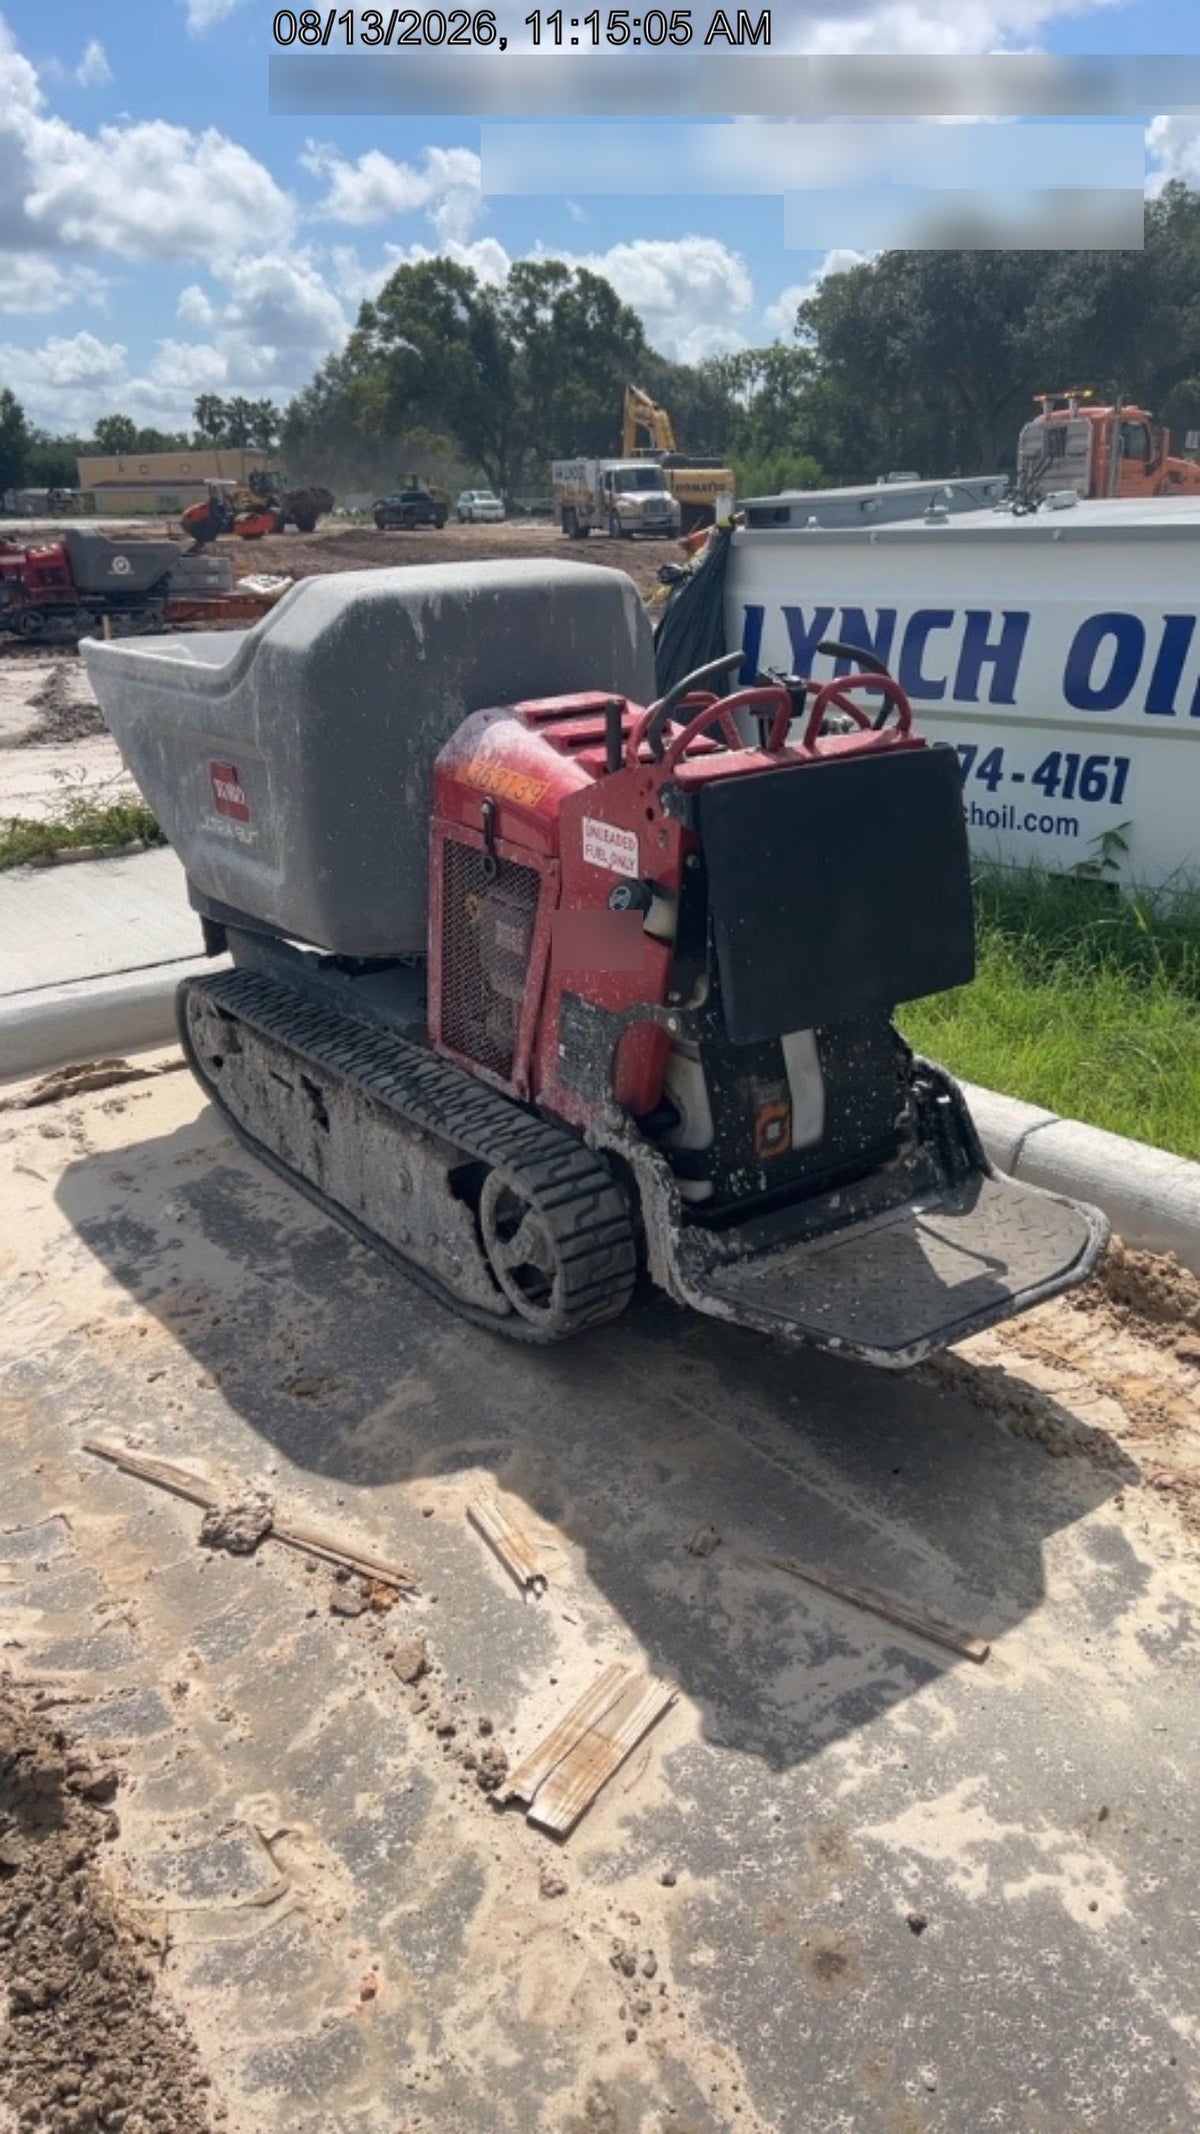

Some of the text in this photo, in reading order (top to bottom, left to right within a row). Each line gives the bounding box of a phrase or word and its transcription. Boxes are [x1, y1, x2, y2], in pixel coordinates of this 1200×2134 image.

[738, 604, 1200, 717] LYNCH OI
[962, 801, 1079, 837] hoil.com
[585, 823, 636, 852] UNLEADED
[585, 843, 636, 871] FUEL ONLY
